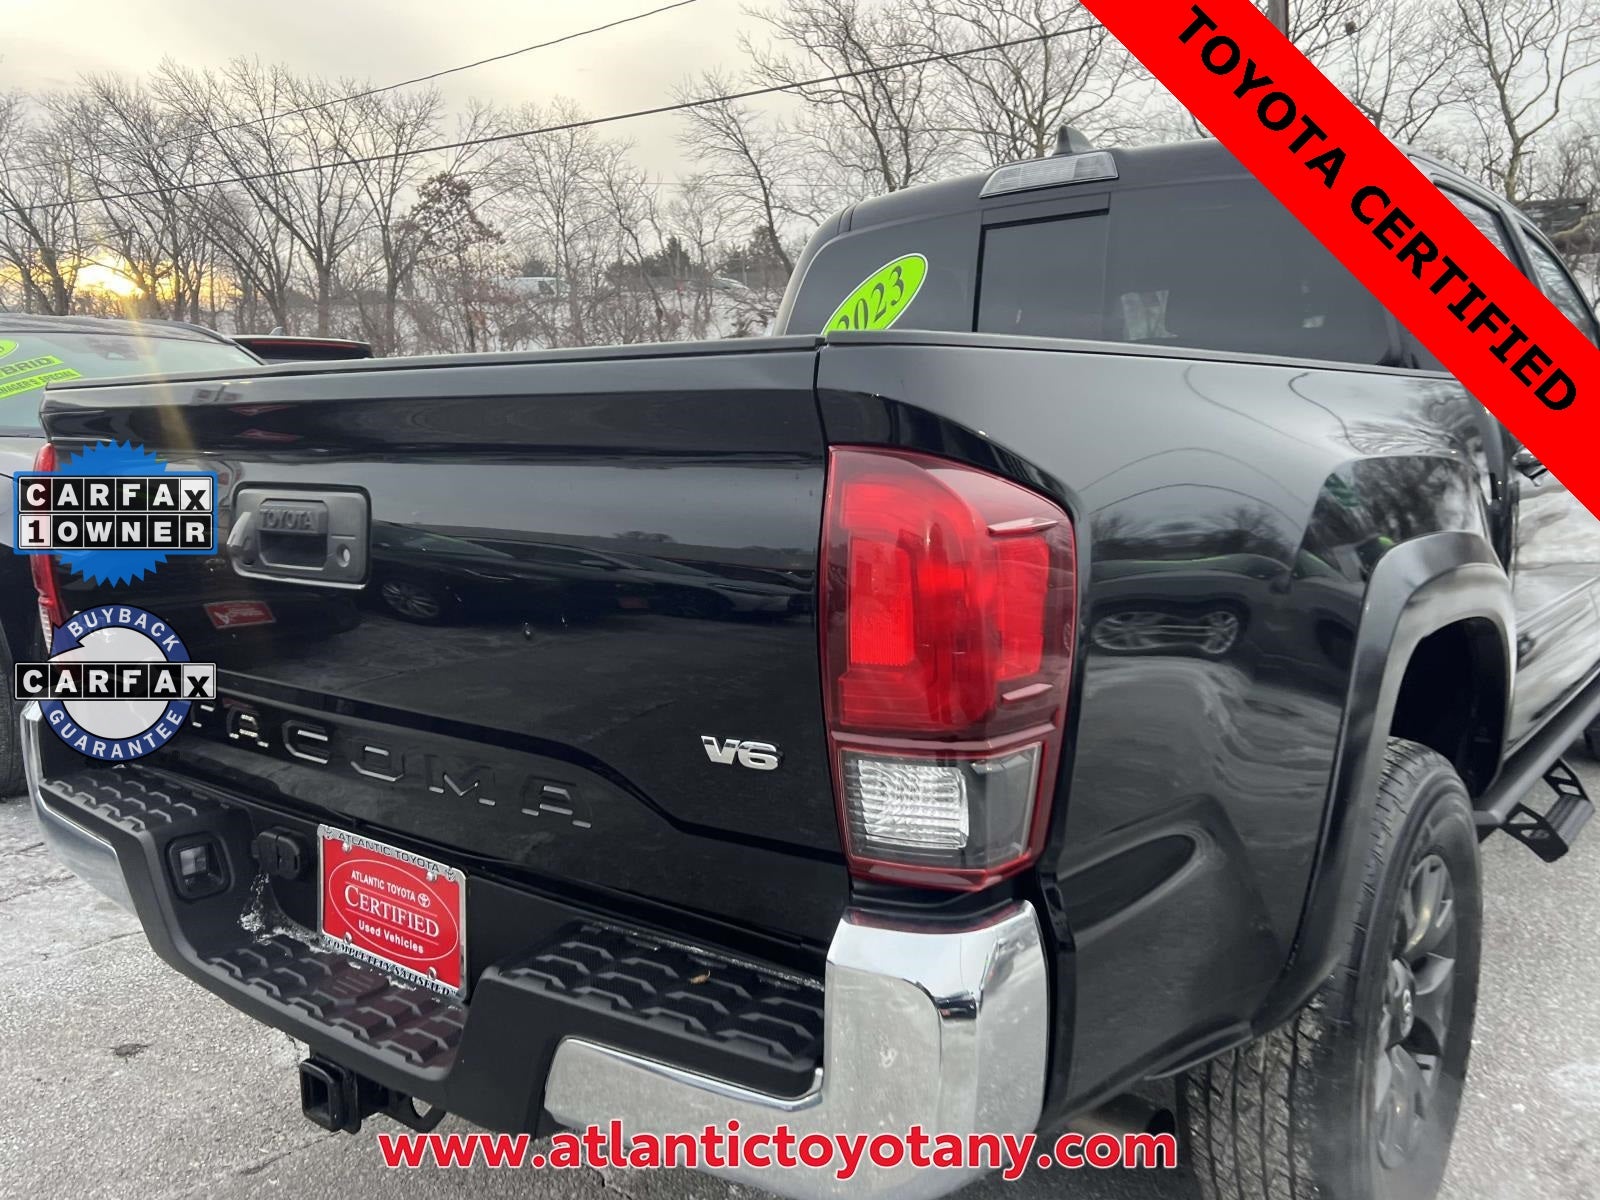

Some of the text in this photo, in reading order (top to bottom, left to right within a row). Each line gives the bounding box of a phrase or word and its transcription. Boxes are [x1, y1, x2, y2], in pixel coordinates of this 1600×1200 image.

[0, 358, 51, 375] BRID
[260, 507, 315, 530] TOYOTA
[700, 735, 779, 771] V6
[338, 832, 440, 873] ATLANTIC TOYOTA
[351, 870, 416, 902] ATLANTIC TOYOTA
[344, 884, 440, 938] CERTIFIED
[358, 919, 424, 954] Used Vehicles
